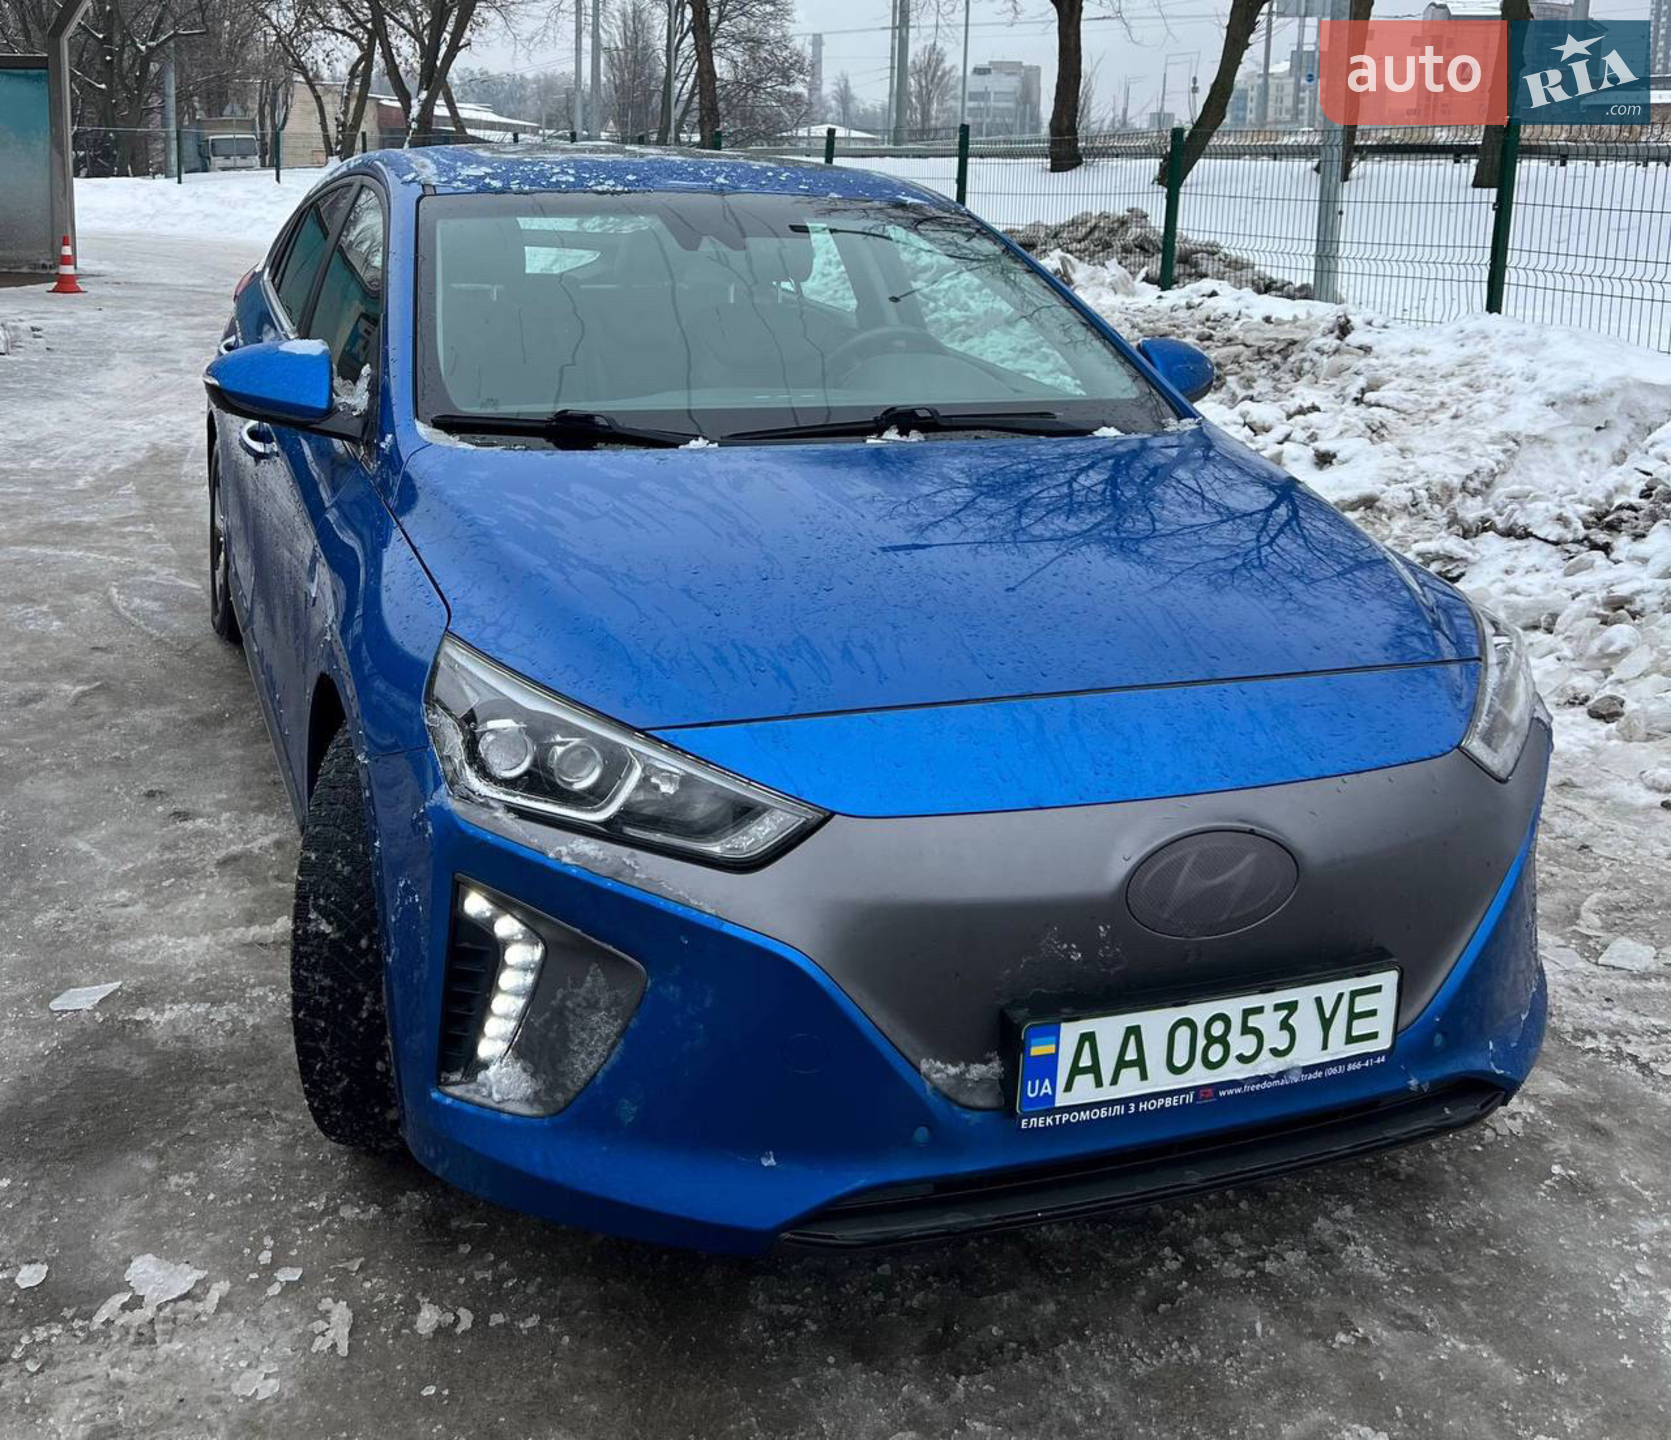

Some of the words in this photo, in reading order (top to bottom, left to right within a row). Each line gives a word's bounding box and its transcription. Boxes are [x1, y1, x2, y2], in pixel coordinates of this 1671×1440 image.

[1063, 1024, 1149, 1093] AA
[1166, 1000, 1299, 1076] 0853
[1314, 984, 1383, 1051] YE
[1324, 1065, 1346, 1077] (063)
[1346, 1055, 1386, 1072] 866-41-44
[1027, 1078, 1053, 1098] UA
[1021, 1105, 1125, 1129] ЕЛЕКТРОМОБІЛІ
[1138, 1091, 1195, 1112] НОРВЕГІЇ
